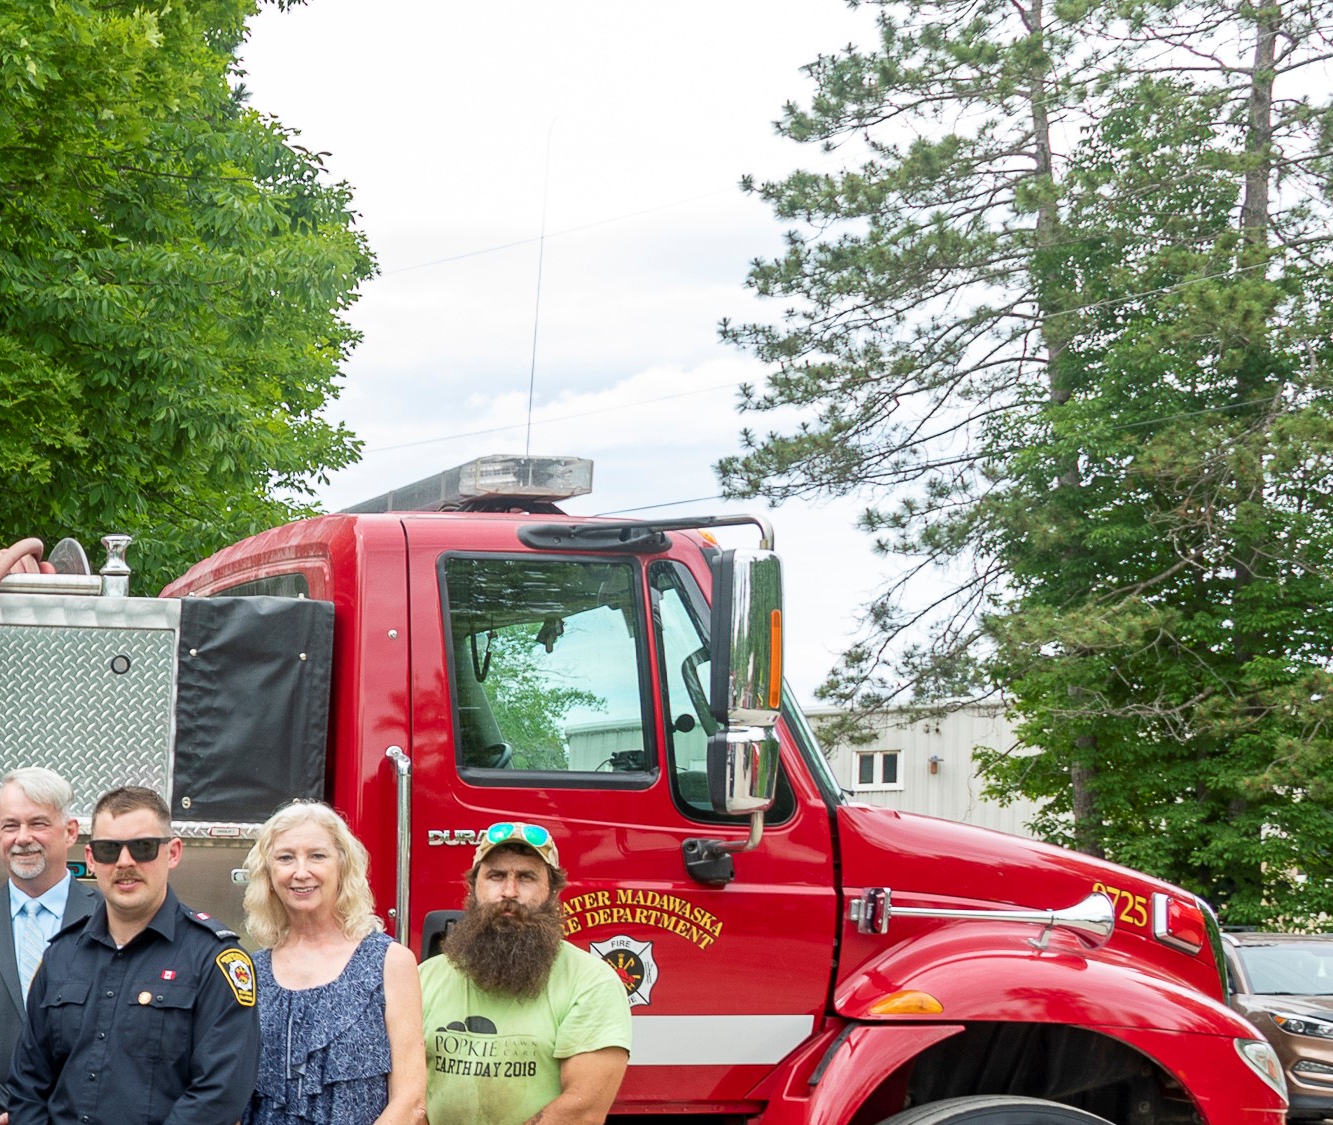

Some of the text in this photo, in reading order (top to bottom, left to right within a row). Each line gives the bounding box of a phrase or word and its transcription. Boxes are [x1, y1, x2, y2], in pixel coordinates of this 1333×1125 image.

[616, 889, 724, 938] MADAWASKA
[585, 907, 714, 951] DEPARTMENT
[610, 940, 632, 949] FIRE
[435, 1035, 498, 1057] POPKIE
[435, 1055, 537, 1078] EARTH DAY 2018
